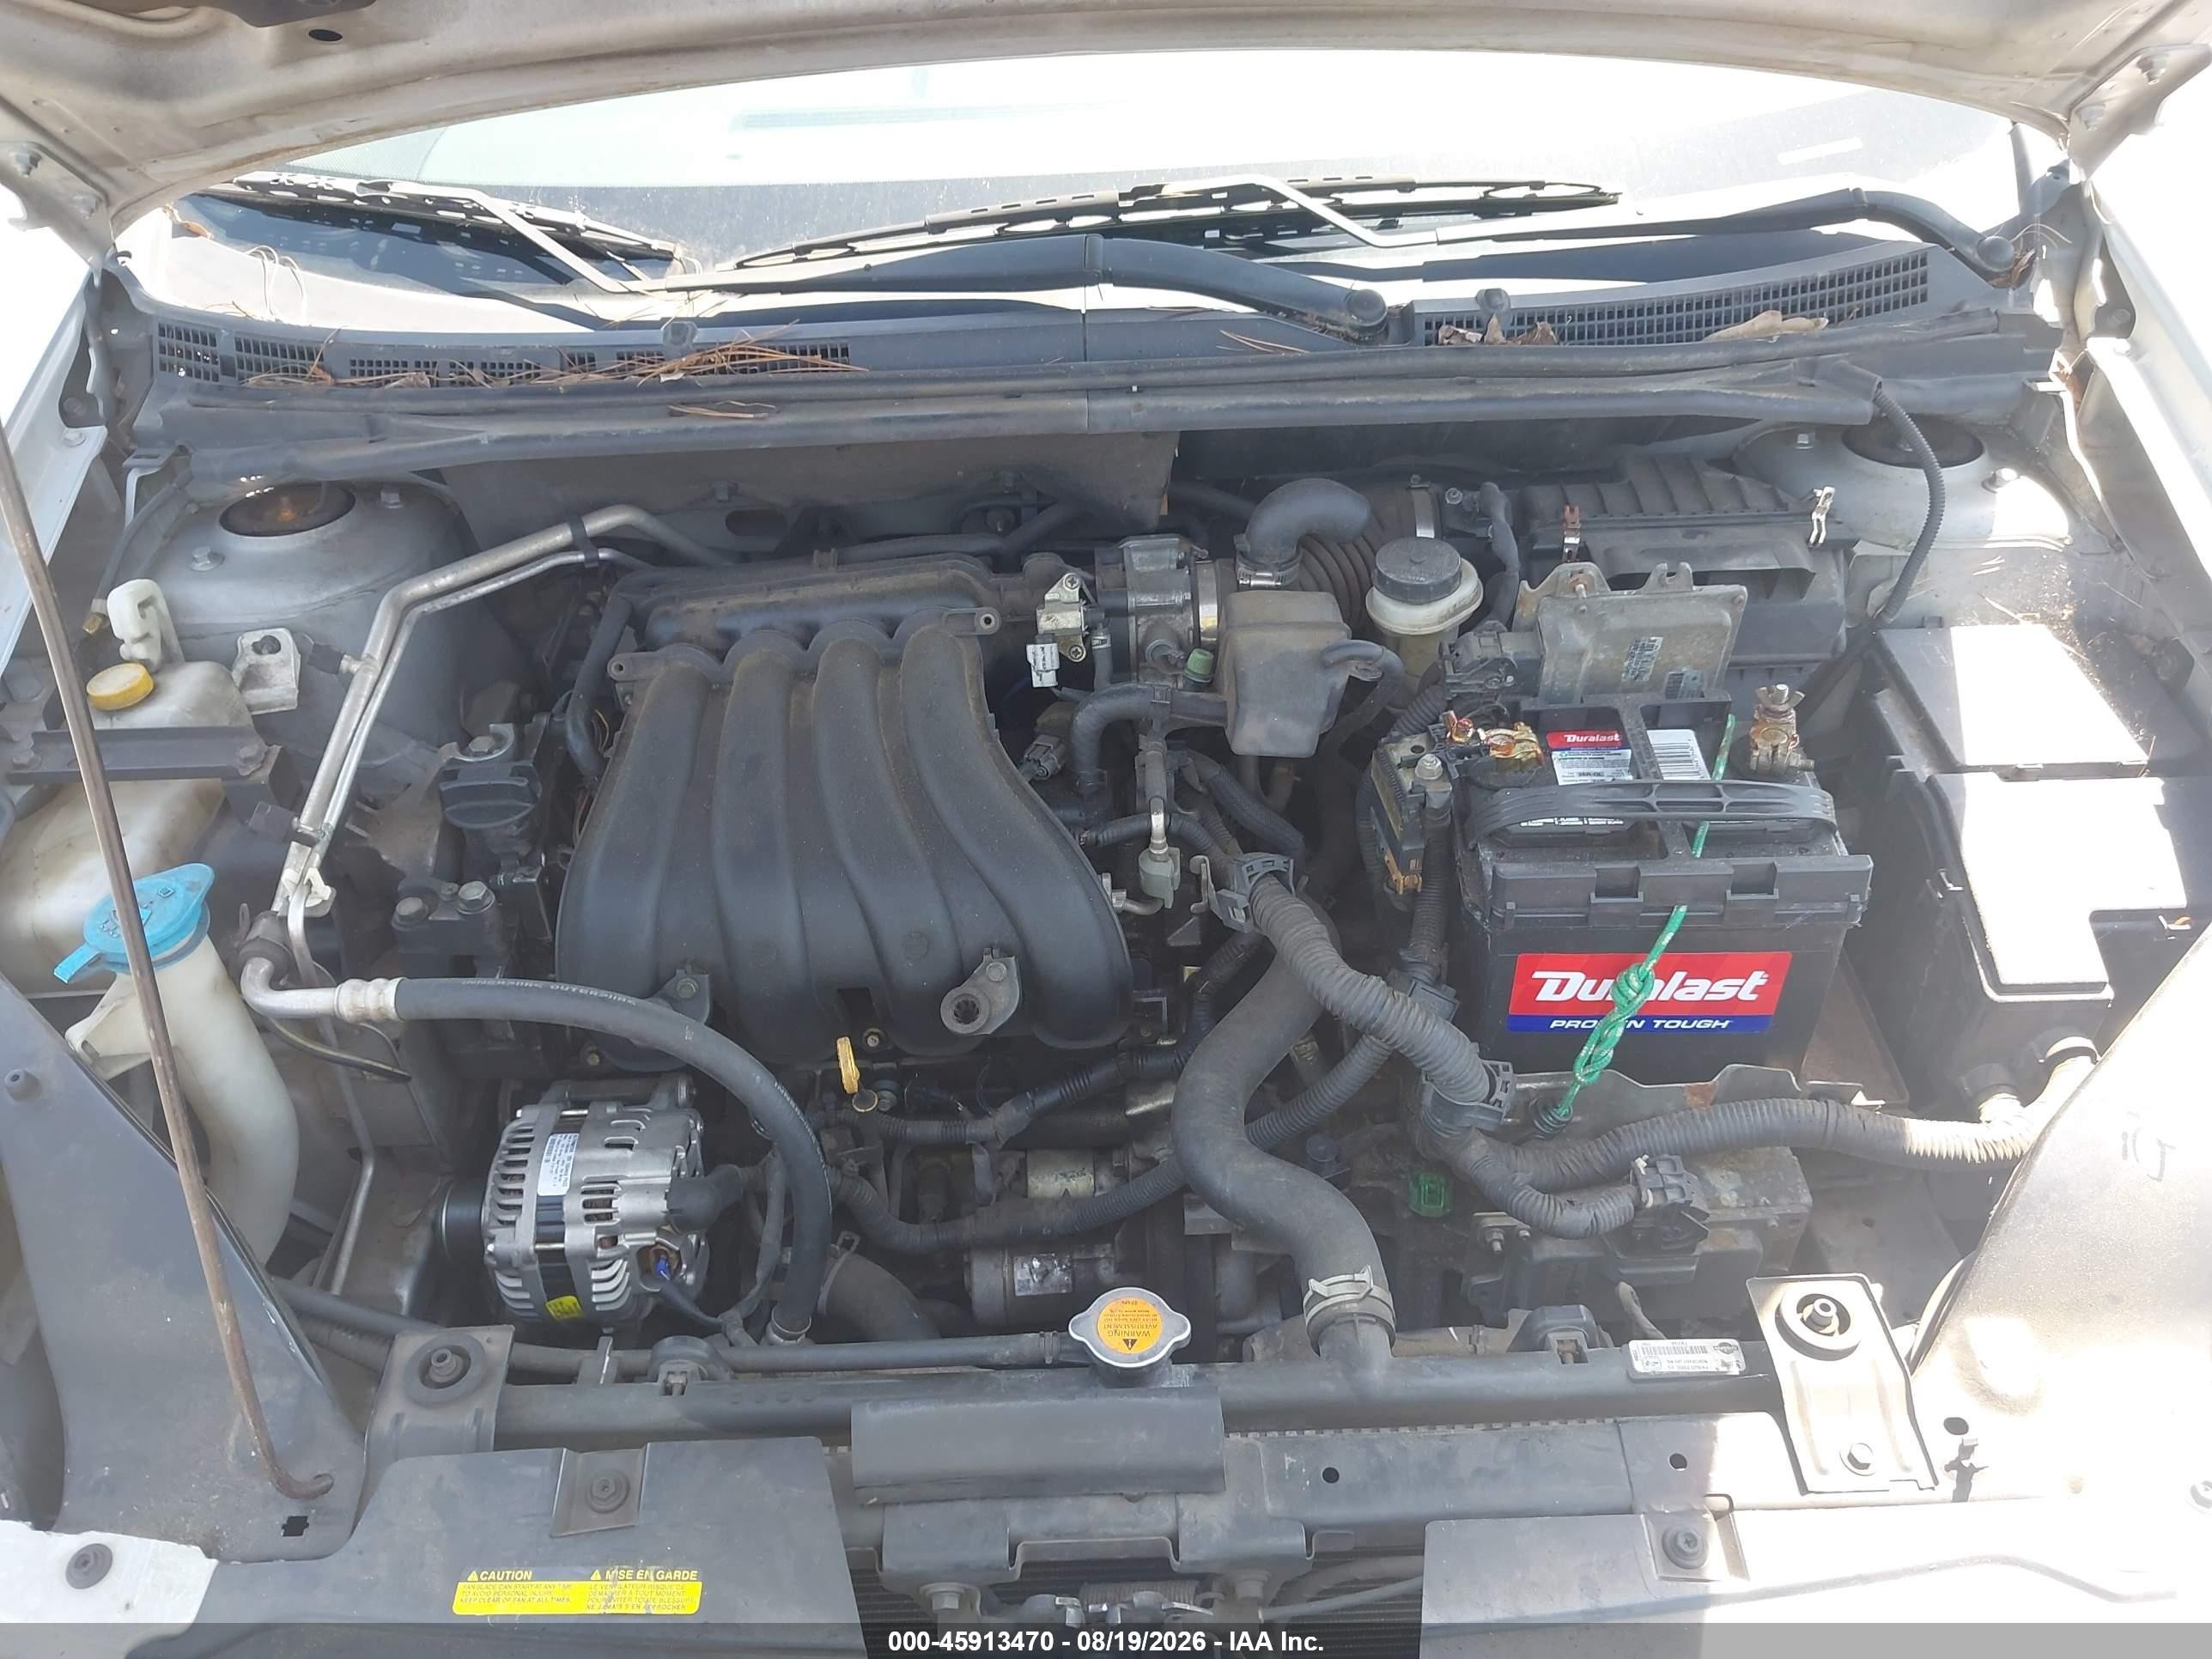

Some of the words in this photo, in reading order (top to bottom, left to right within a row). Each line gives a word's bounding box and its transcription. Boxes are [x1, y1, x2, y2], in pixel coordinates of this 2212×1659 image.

[1564, 732, 1621, 742] Duralast
[1531, 970, 1769, 1002] Dulast
[1549, 1019, 1645, 1029] PRON
[1653, 1019, 1729, 1029] TOUGH
[479, 1570, 532, 1581] CAUTION
[605, 1570, 634, 1580] MISE
[636, 1570, 653, 1581] EN
[656, 1570, 698, 1581] GARDE
